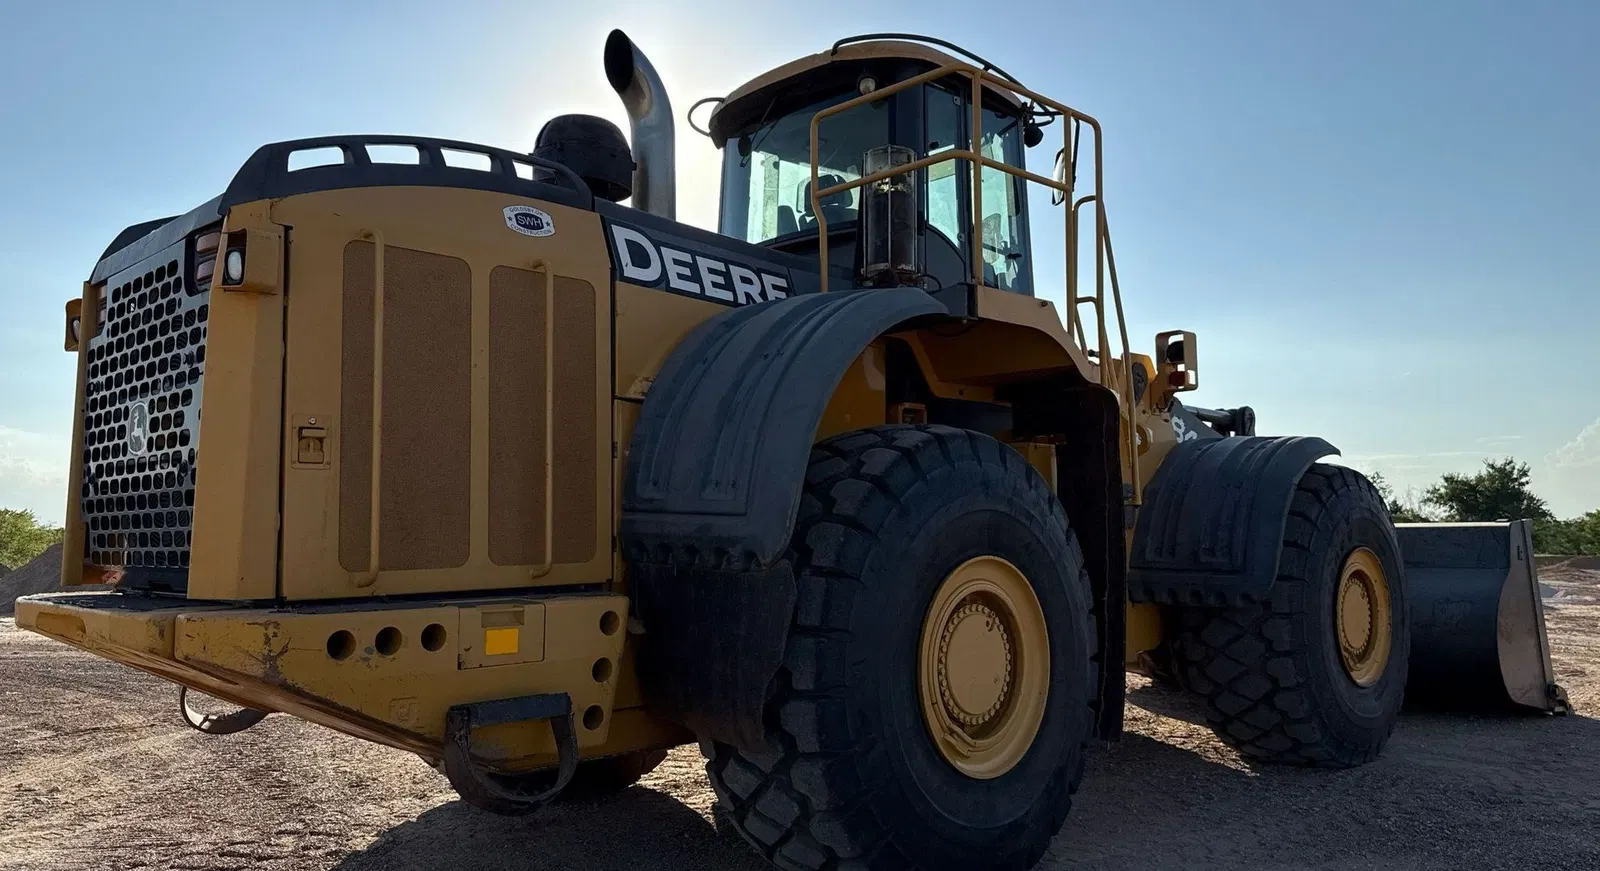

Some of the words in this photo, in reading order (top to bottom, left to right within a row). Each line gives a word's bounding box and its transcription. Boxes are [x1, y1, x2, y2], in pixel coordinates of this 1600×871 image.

[517, 215, 542, 227] SWH
[510, 224, 552, 235] CONSTRUCTION
[611, 224, 788, 305] DEERE
